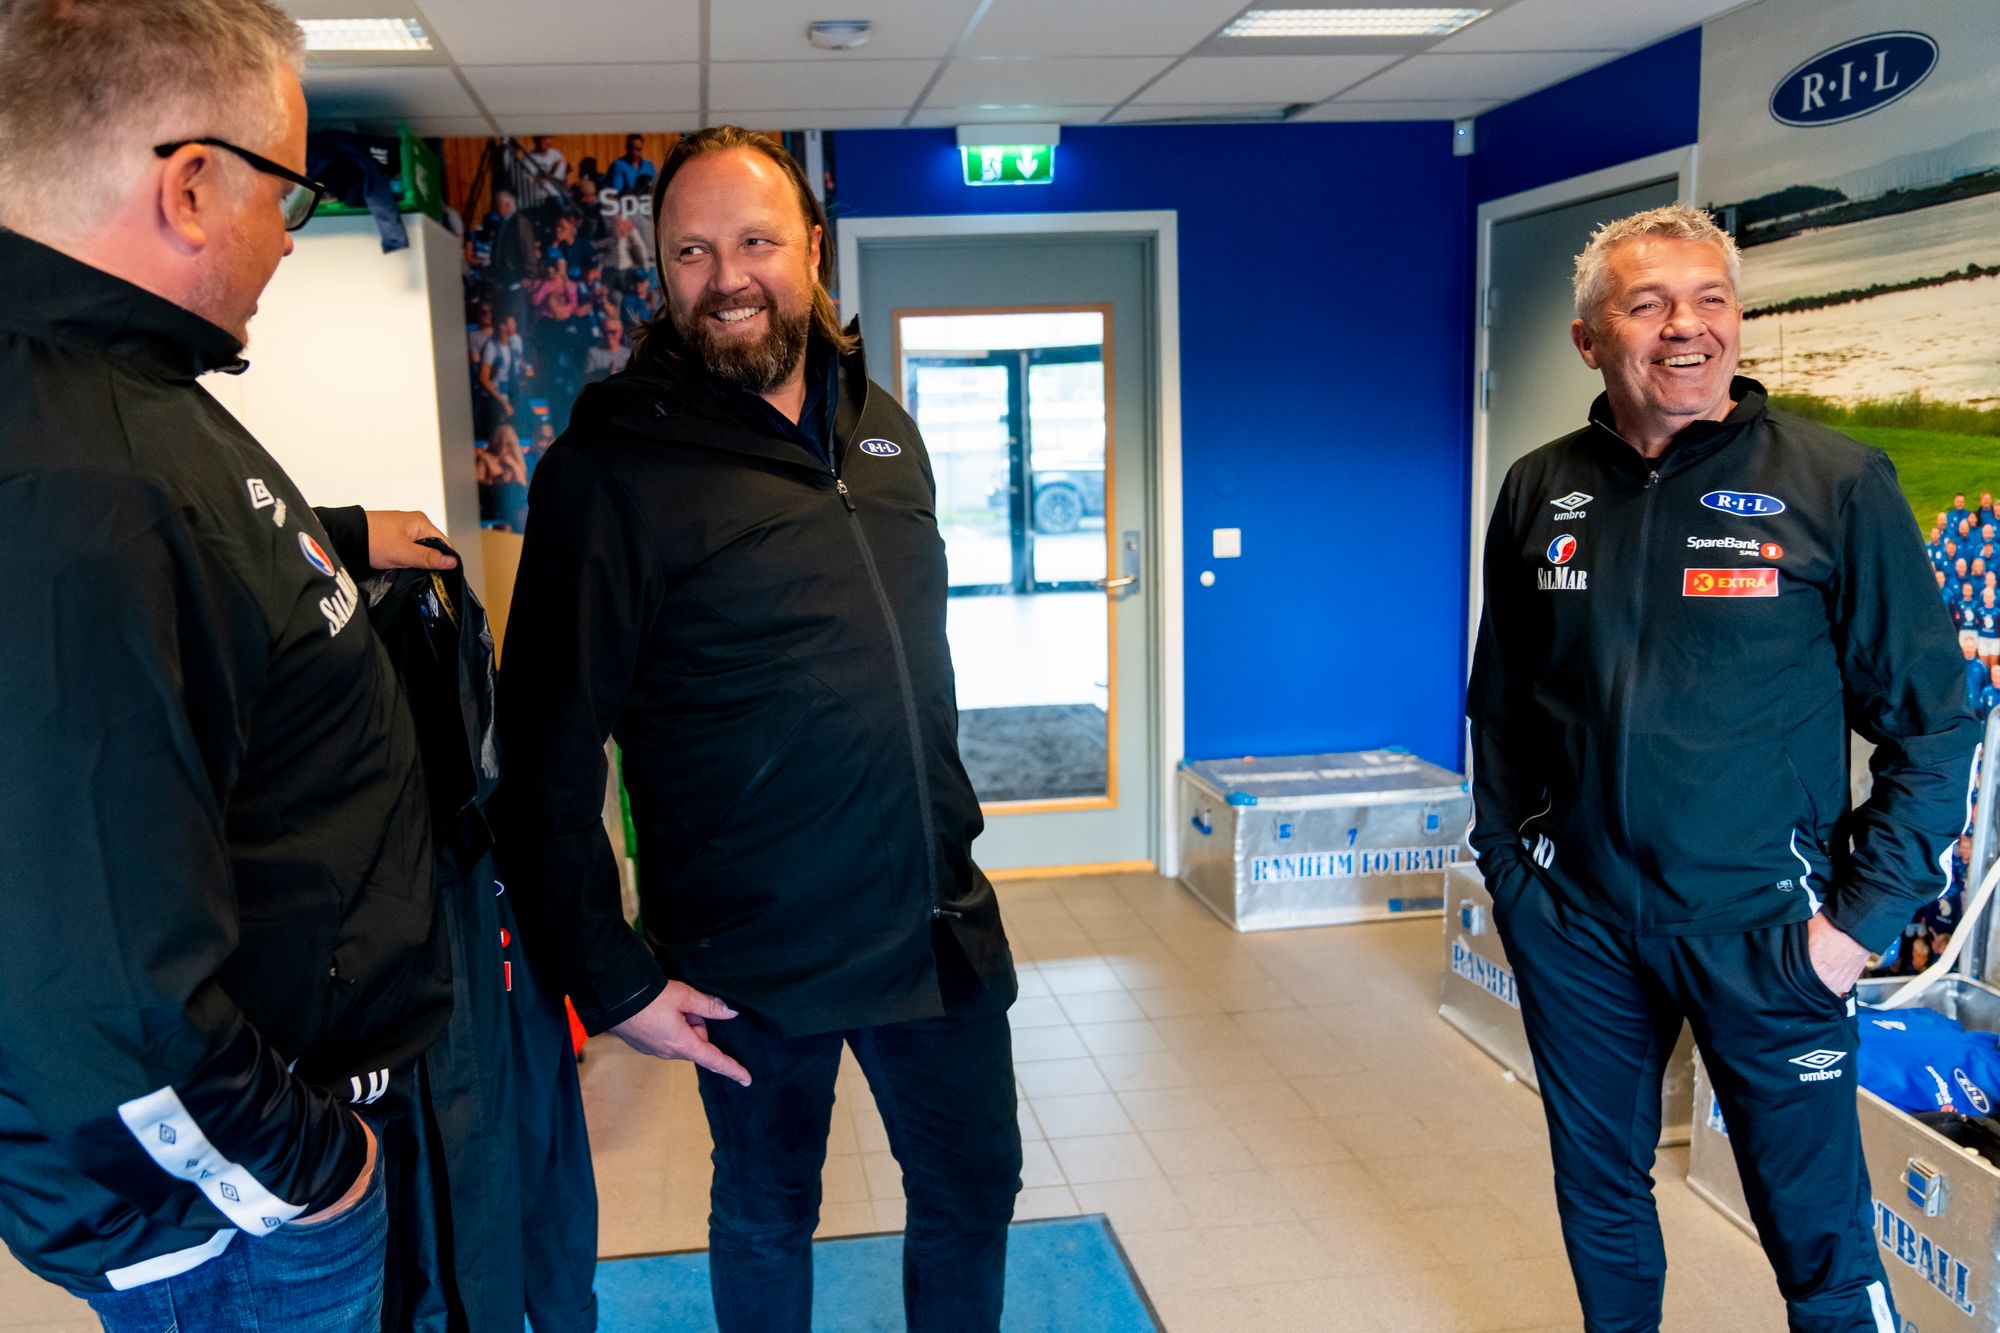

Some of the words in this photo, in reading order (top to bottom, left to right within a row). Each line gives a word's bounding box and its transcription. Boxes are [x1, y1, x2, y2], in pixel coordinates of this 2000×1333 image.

[1554, 510, 1587, 521] umbro
[1687, 536, 1760, 550] SpareBank
[1718, 577, 1768, 588] EXTRA
[1253, 851, 1353, 882] RANHEIM
[1453, 941, 1519, 1005] RANHEI
[1799, 1069, 1842, 1082] umbro
